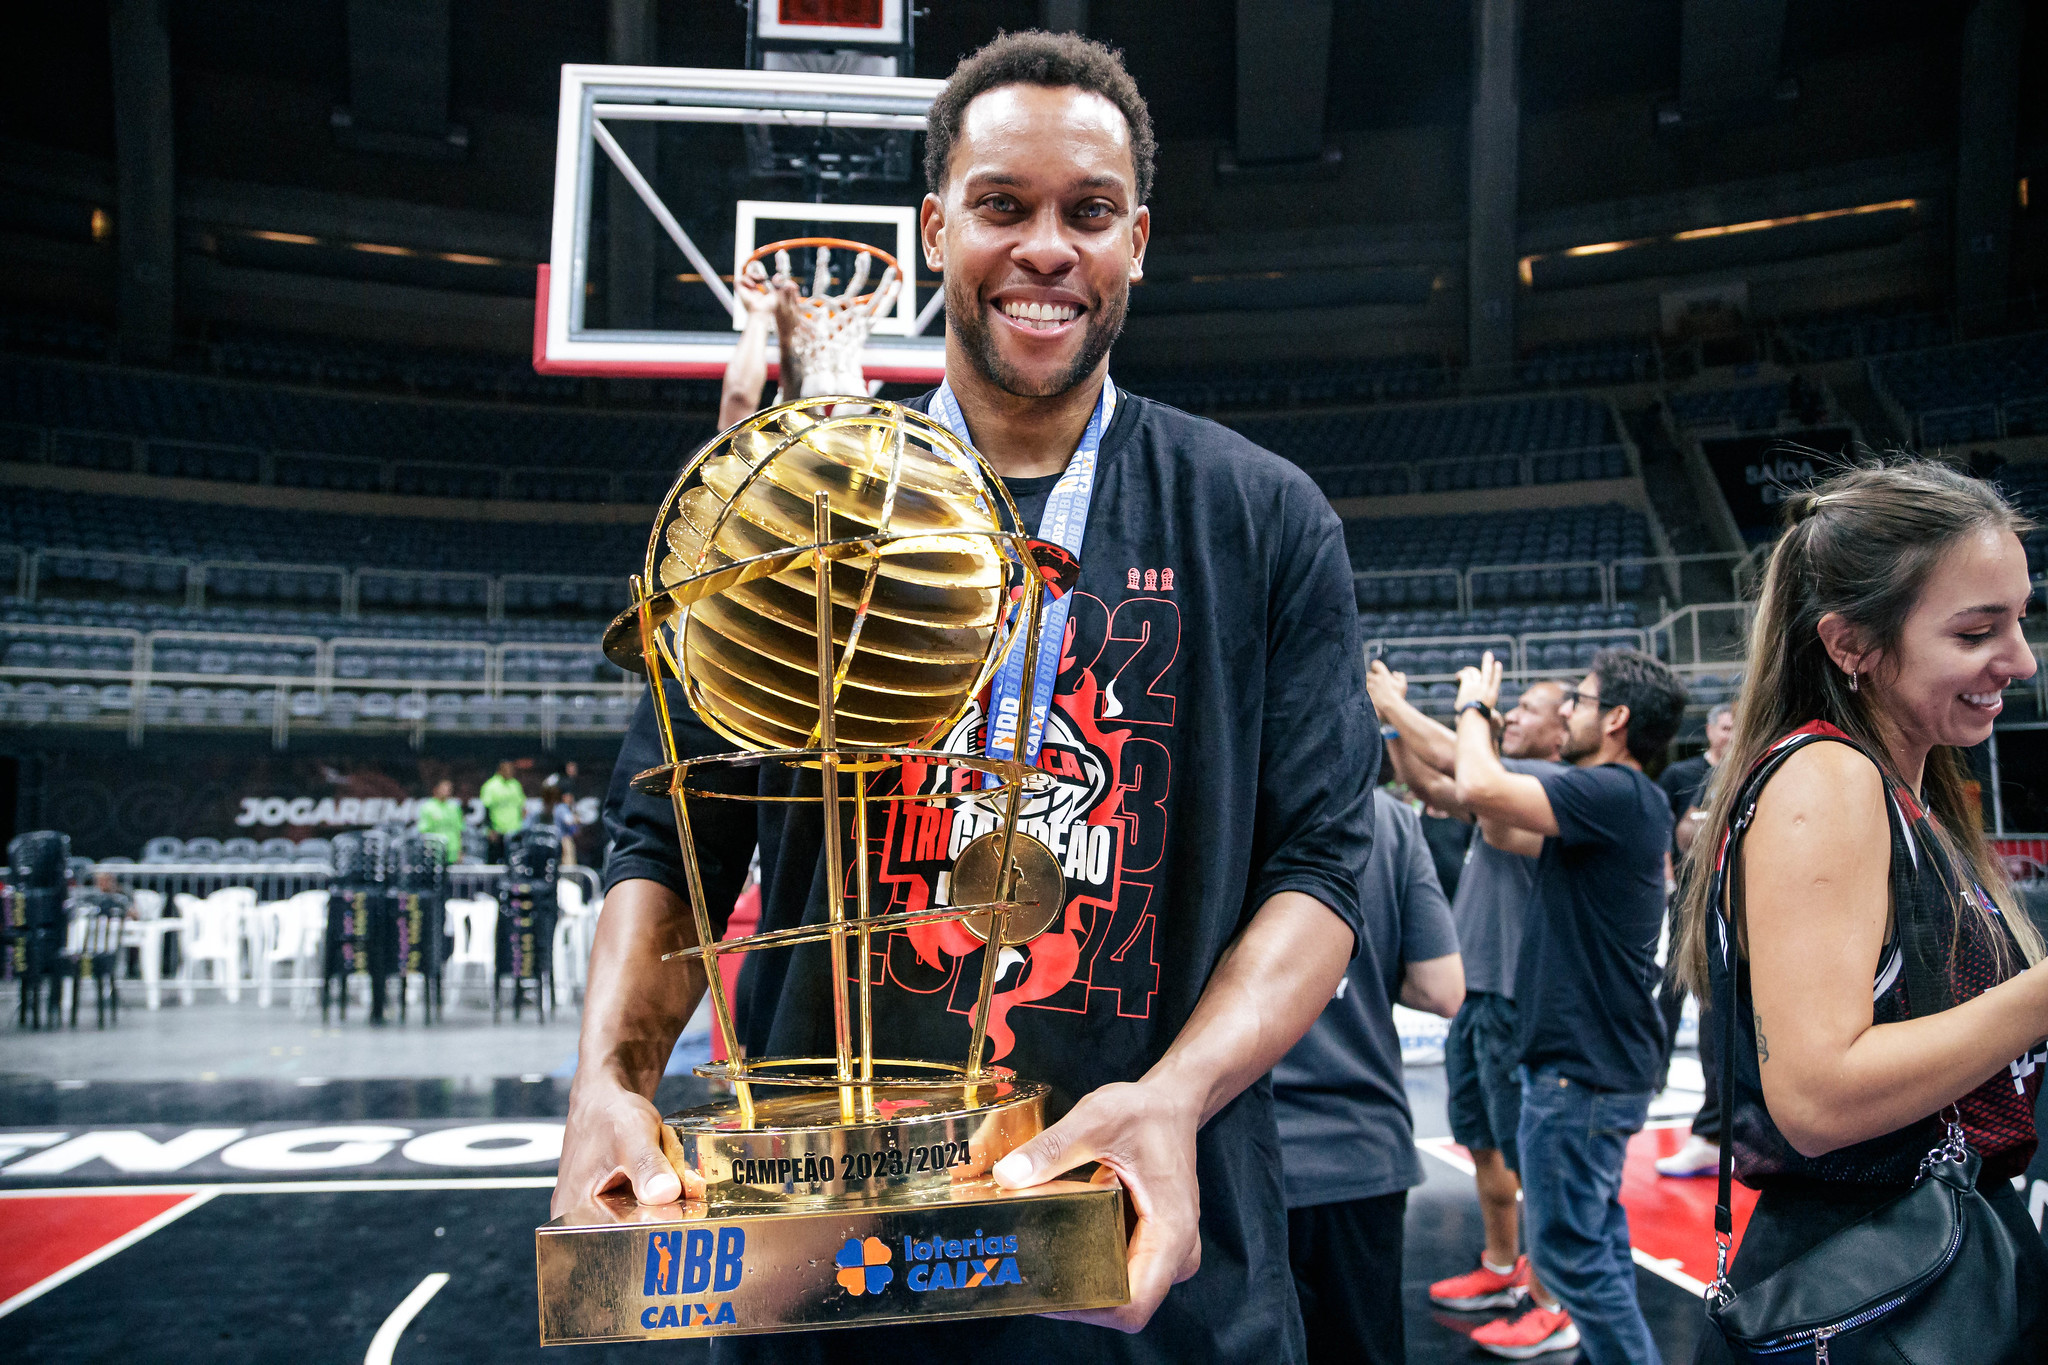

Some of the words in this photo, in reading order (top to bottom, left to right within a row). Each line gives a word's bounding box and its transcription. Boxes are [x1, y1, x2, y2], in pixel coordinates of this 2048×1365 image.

[235, 797, 461, 826] JOGAREM
[731, 1152, 835, 1185] CAMPEÃO
[841, 1140, 971, 1181] 2023/2024
[643, 1227, 745, 1296] NBB
[904, 1228, 1018, 1262] loterias
[907, 1257, 1022, 1292] CAIXA
[641, 1302, 737, 1329] CAIXA
